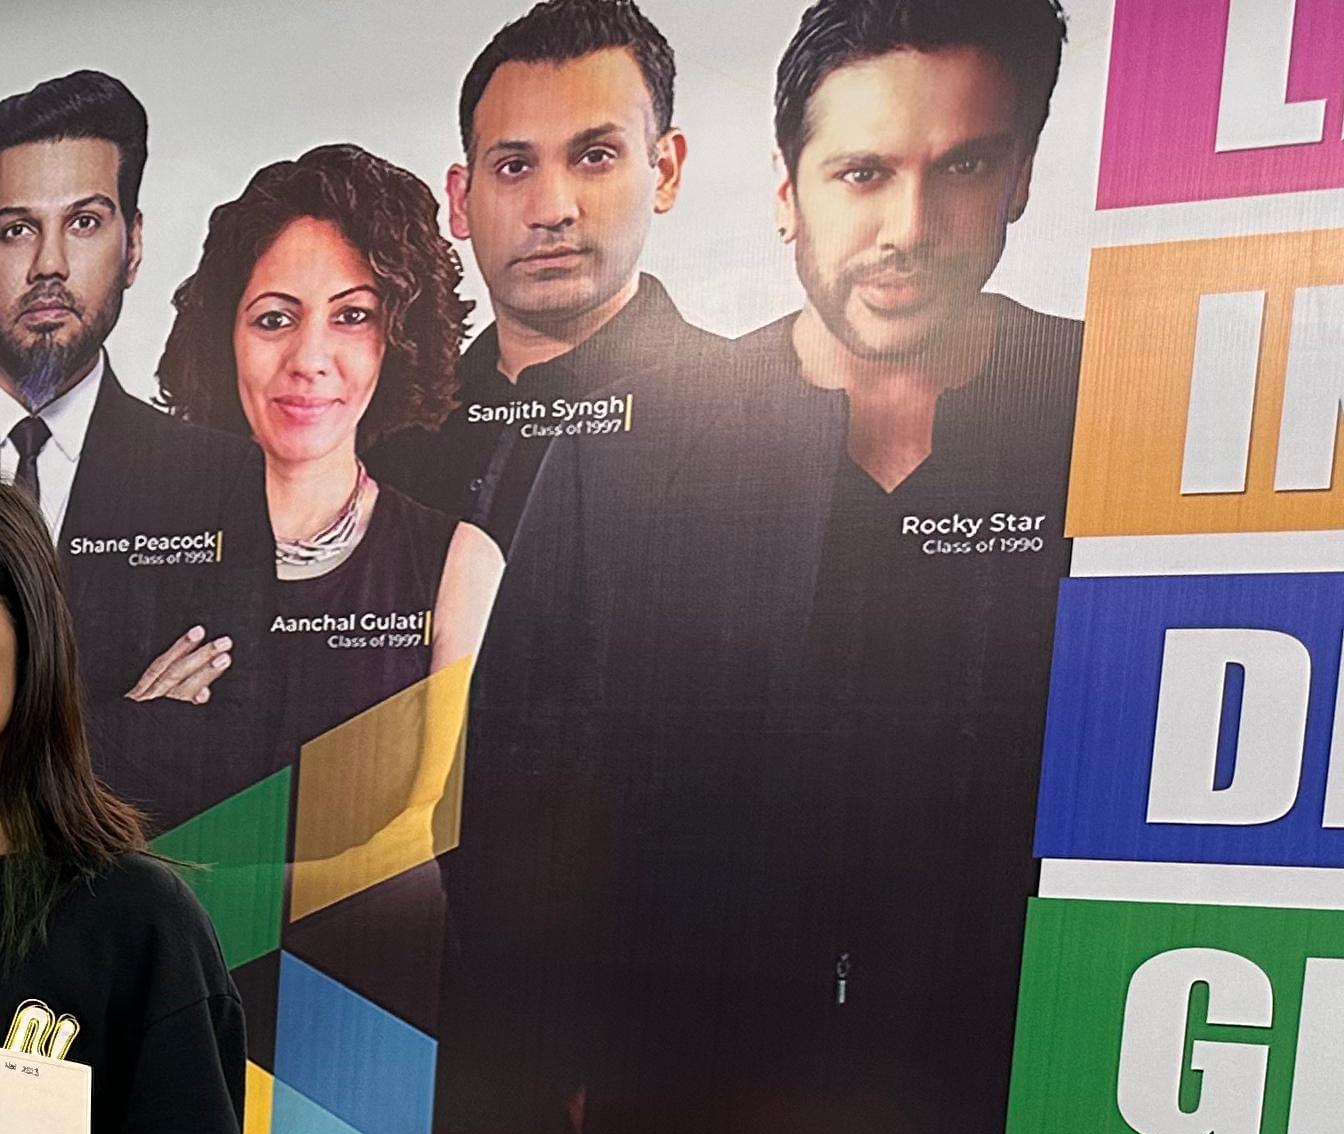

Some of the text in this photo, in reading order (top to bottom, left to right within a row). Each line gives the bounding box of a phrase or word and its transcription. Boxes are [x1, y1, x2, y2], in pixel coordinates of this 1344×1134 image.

[468, 395, 625, 425] Sanjith Syngh
[520, 419, 622, 438] Class of 1997
[902, 512, 1046, 538] Rocky Star
[70, 531, 216, 555] Shane Peacock
[922, 536, 1044, 555] Class of 1990
[128, 550, 214, 566] Class of 1992
[270, 611, 424, 632] Aanchal Gulati
[327, 633, 422, 648] Class of 1997
